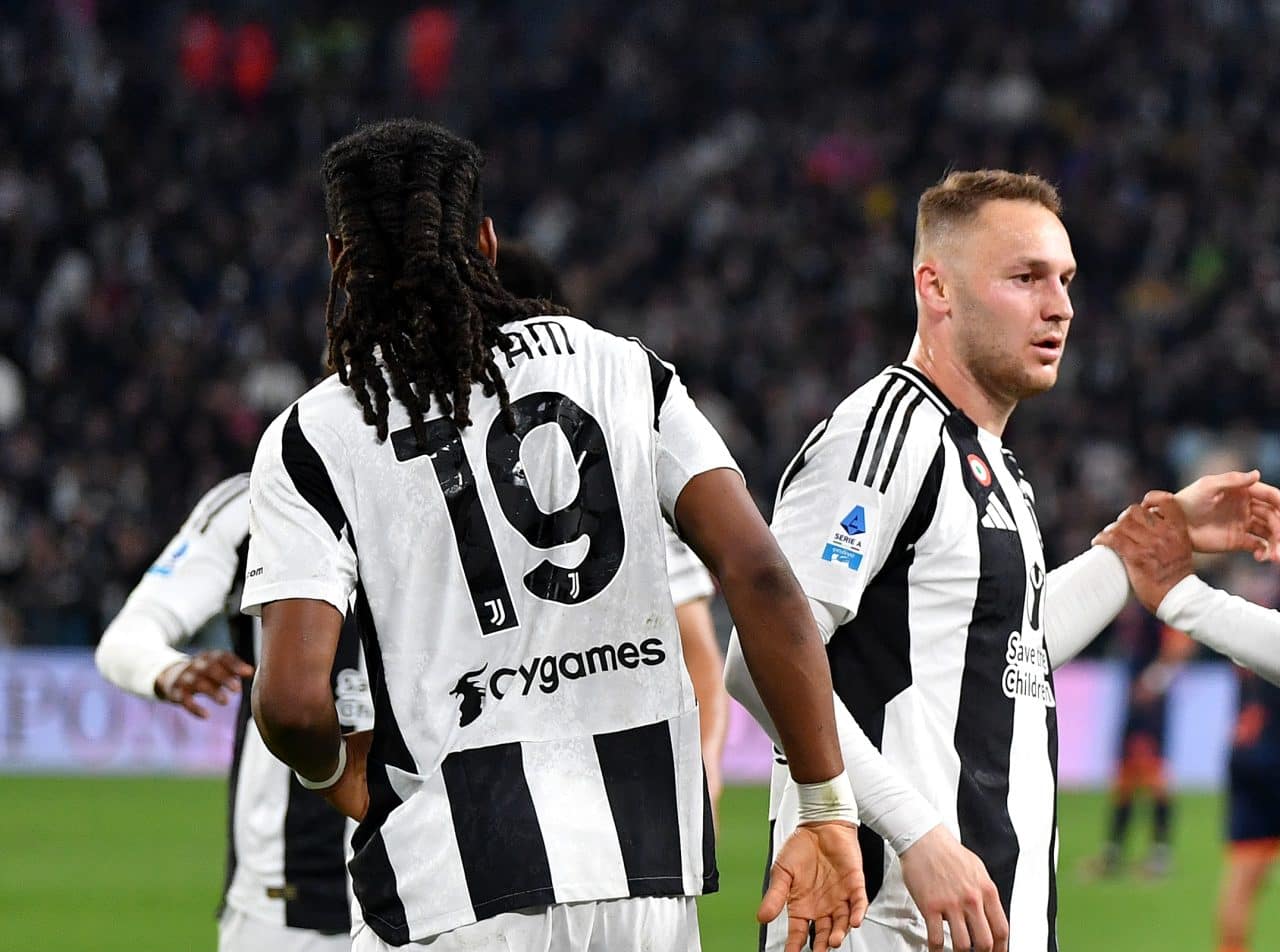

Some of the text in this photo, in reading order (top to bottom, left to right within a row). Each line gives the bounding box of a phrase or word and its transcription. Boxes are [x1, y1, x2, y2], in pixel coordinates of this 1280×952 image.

[389, 390, 627, 637] 19
[834, 533, 856, 545] SERIE
[1009, 636, 1035, 665] Save
[1005, 669, 1052, 703] Children
